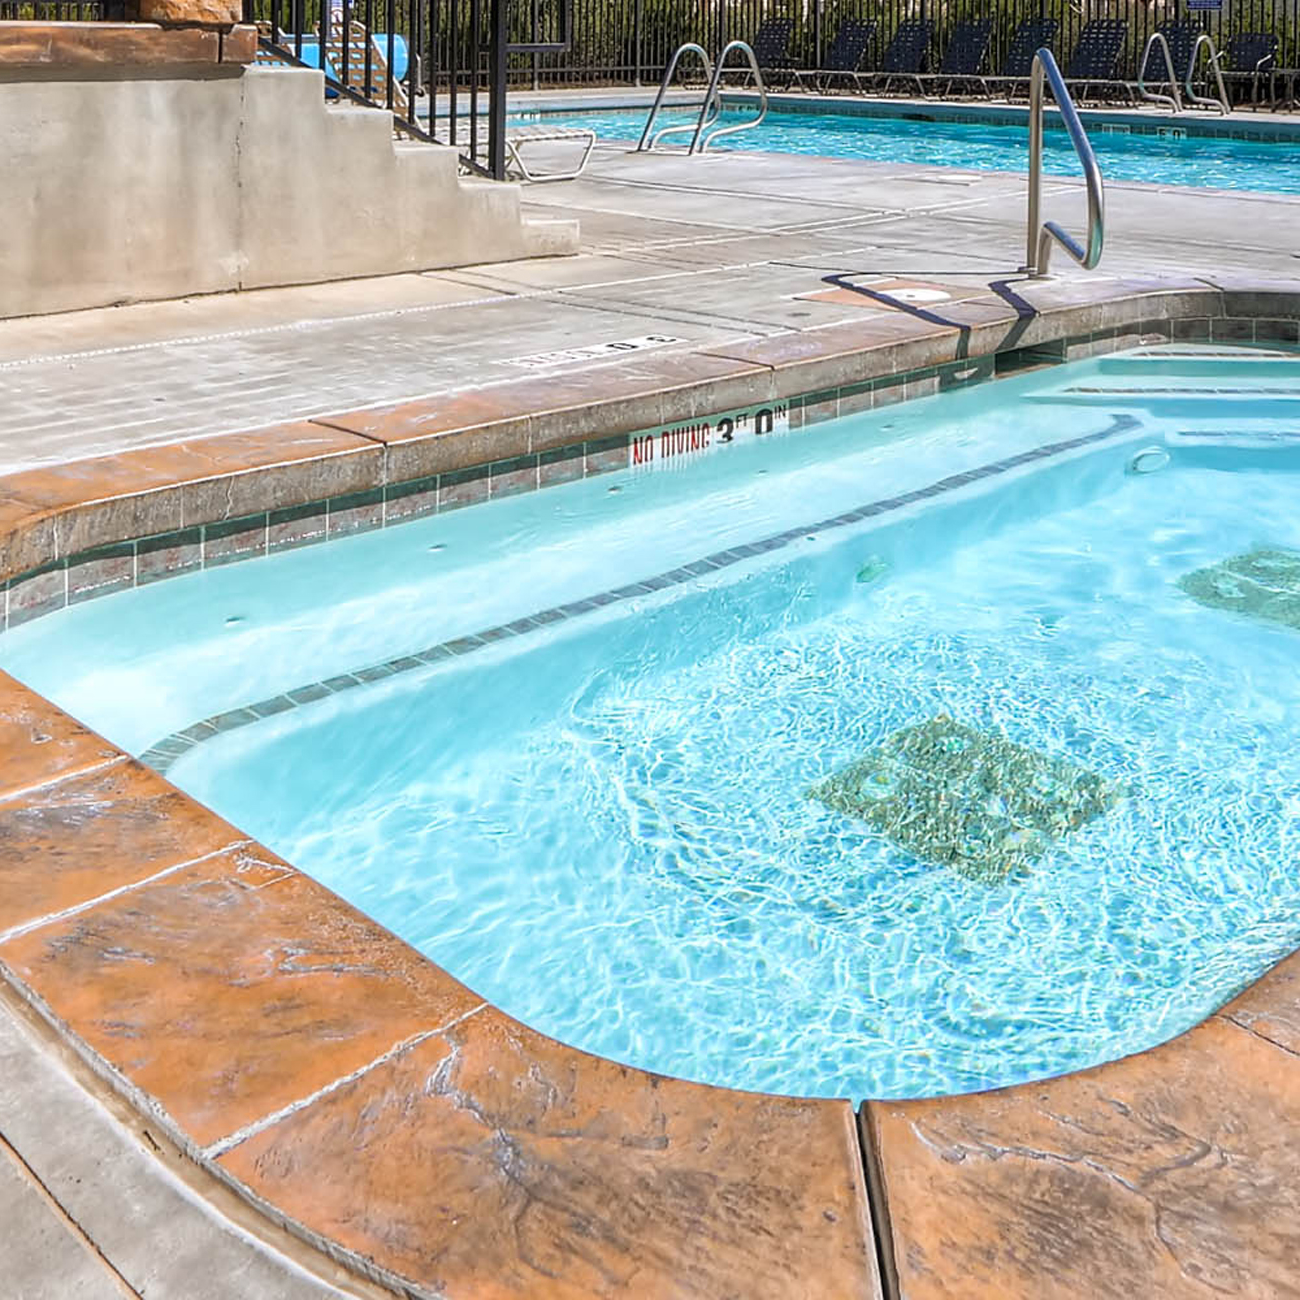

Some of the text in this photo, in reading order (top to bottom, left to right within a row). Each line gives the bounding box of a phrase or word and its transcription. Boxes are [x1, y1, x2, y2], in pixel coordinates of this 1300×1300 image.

[632, 404, 787, 465] NO DIVING 3 FT 0 IN
